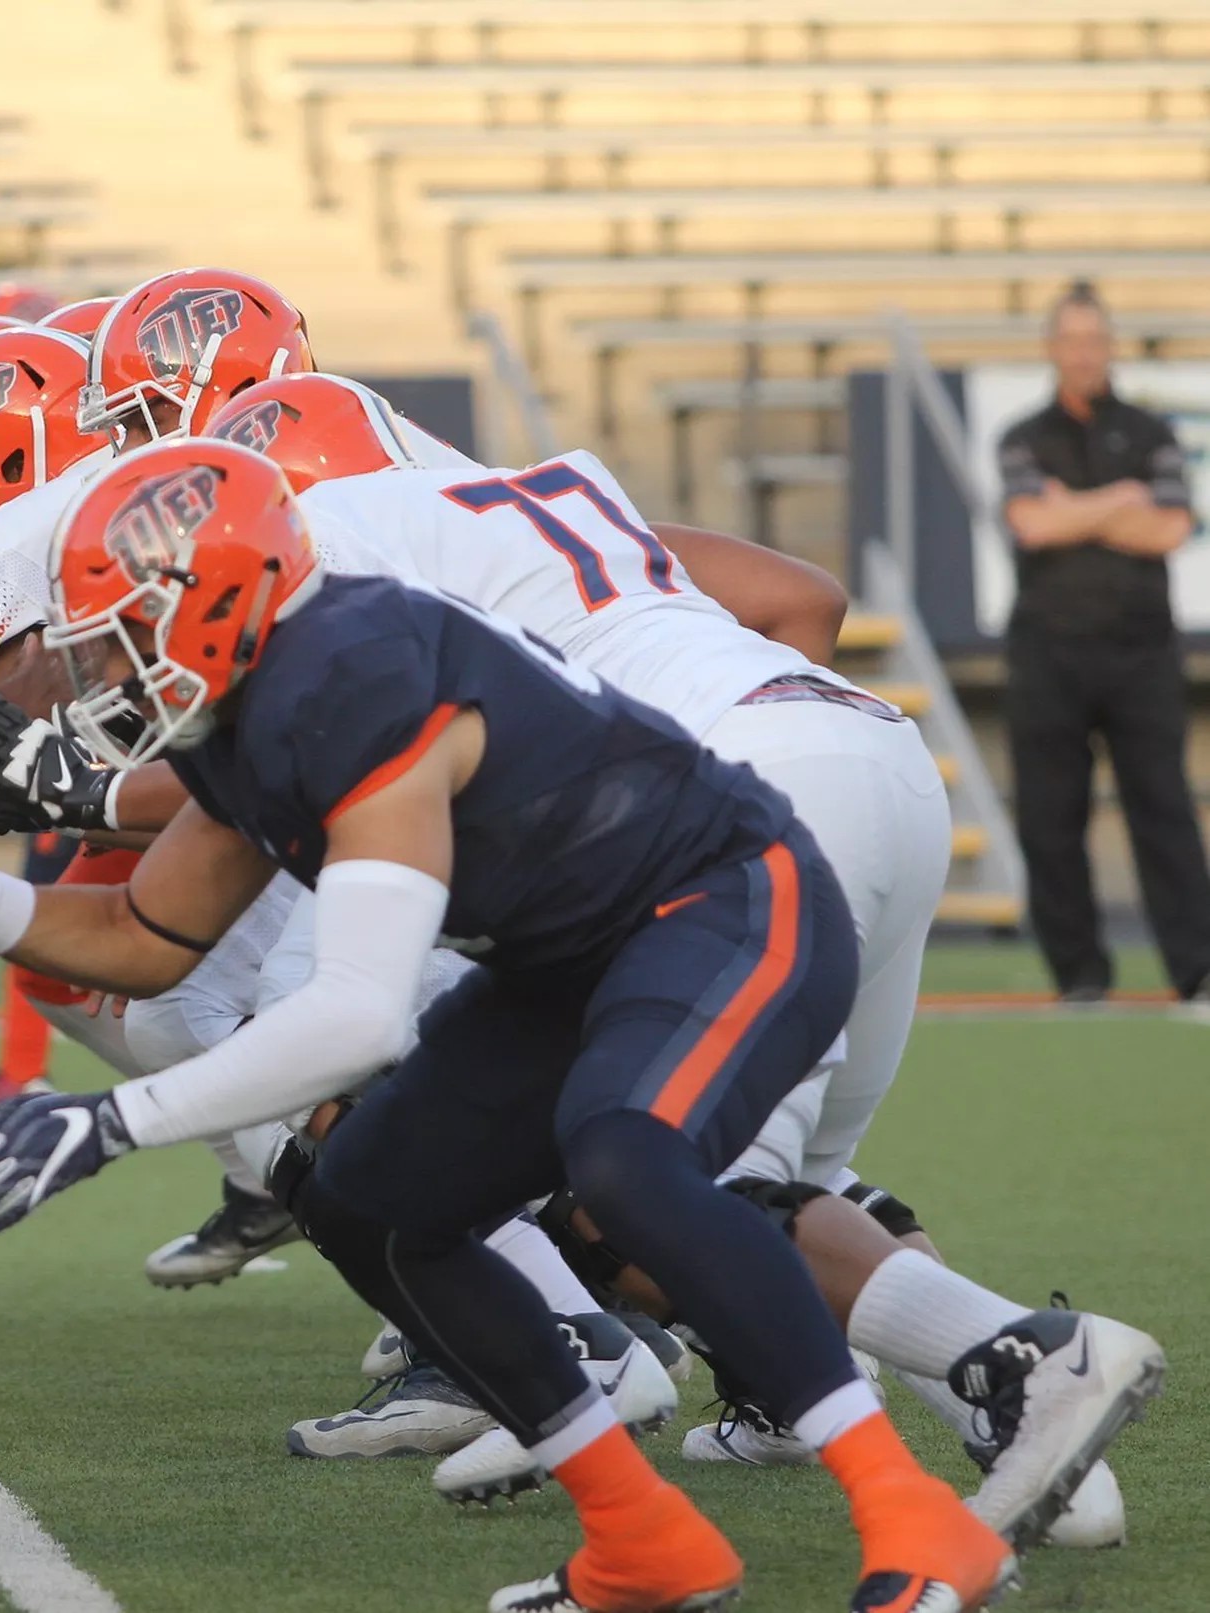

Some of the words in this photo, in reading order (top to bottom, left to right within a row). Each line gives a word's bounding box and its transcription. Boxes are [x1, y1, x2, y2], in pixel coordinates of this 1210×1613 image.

[136, 288, 242, 382] UTEP
[103, 466, 217, 586] UTEP
[439, 461, 682, 614] 77
